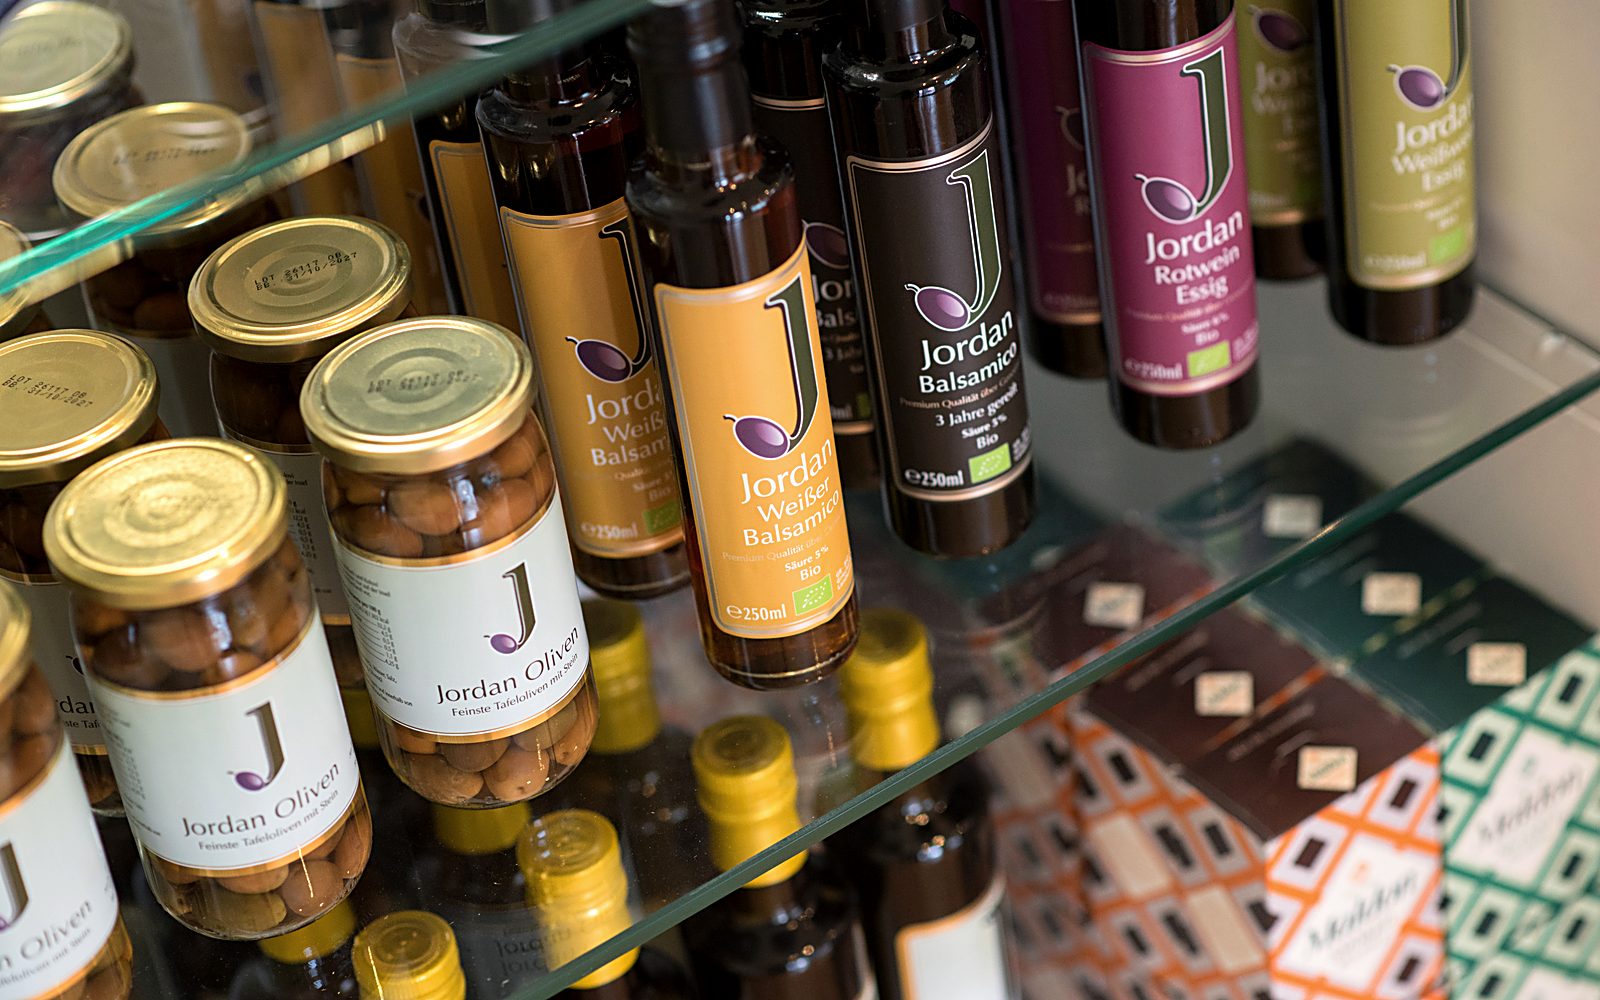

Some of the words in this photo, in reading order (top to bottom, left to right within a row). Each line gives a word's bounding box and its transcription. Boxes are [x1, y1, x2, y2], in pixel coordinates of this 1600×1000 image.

[1145, 211, 1244, 265] Jordan
[1154, 245, 1241, 285] Rotwein
[1176, 275, 1229, 305] Essig
[919, 341, 1018, 394] Balsamico
[920, 311, 1013, 371] Jordan
[935, 414, 945, 427] 3
[949, 407, 985, 427] Jahre
[976, 433, 999, 450] Bio
[741, 439, 833, 505] Jordan
[743, 489, 840, 547] Balsamico
[757, 476, 830, 523] Weißer
[766, 545, 805, 561] Qualität
[784, 555, 814, 572] Säure
[799, 564, 822, 581] Bio
[437, 675, 518, 705] Jordan
[525, 626, 579, 682] Oliven
[451, 705, 492, 717] Feinste
[494, 682, 549, 711] Tafeloliven
[549, 671, 564, 686] mit
[563, 652, 579, 673] Stein
[182, 813, 267, 838] Jordan
[274, 763, 340, 819] Oliven
[198, 840, 239, 852] Feinste
[243, 820, 302, 848] Tafeloliven
[303, 807, 320, 824] mit
[319, 788, 339, 811] Stein
[20, 900, 93, 961] Oliven
